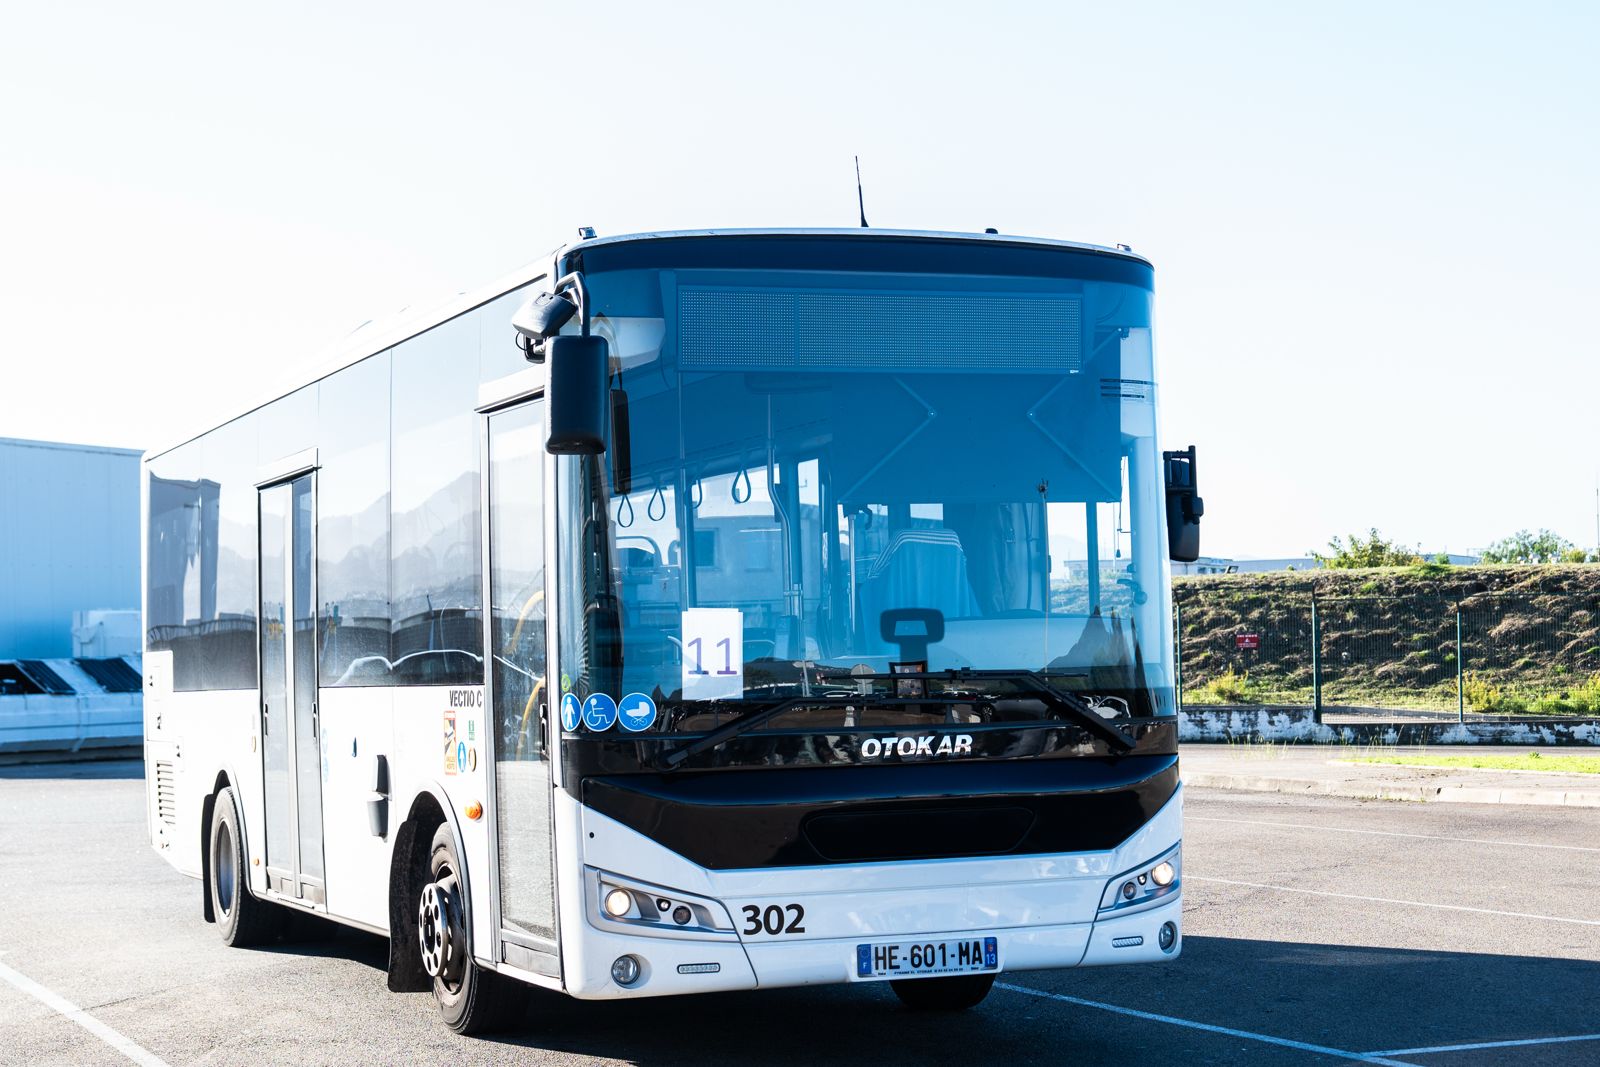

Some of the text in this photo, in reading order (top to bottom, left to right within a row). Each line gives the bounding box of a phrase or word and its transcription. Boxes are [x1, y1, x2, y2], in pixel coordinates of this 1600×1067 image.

[687, 637, 738, 675] 11
[449, 690, 482, 708] VECTIO C
[861, 734, 973, 759] OTOKAR
[742, 903, 806, 935] 302
[874, 941, 983, 970] HE-601-MA
[986, 953, 996, 964] 13
